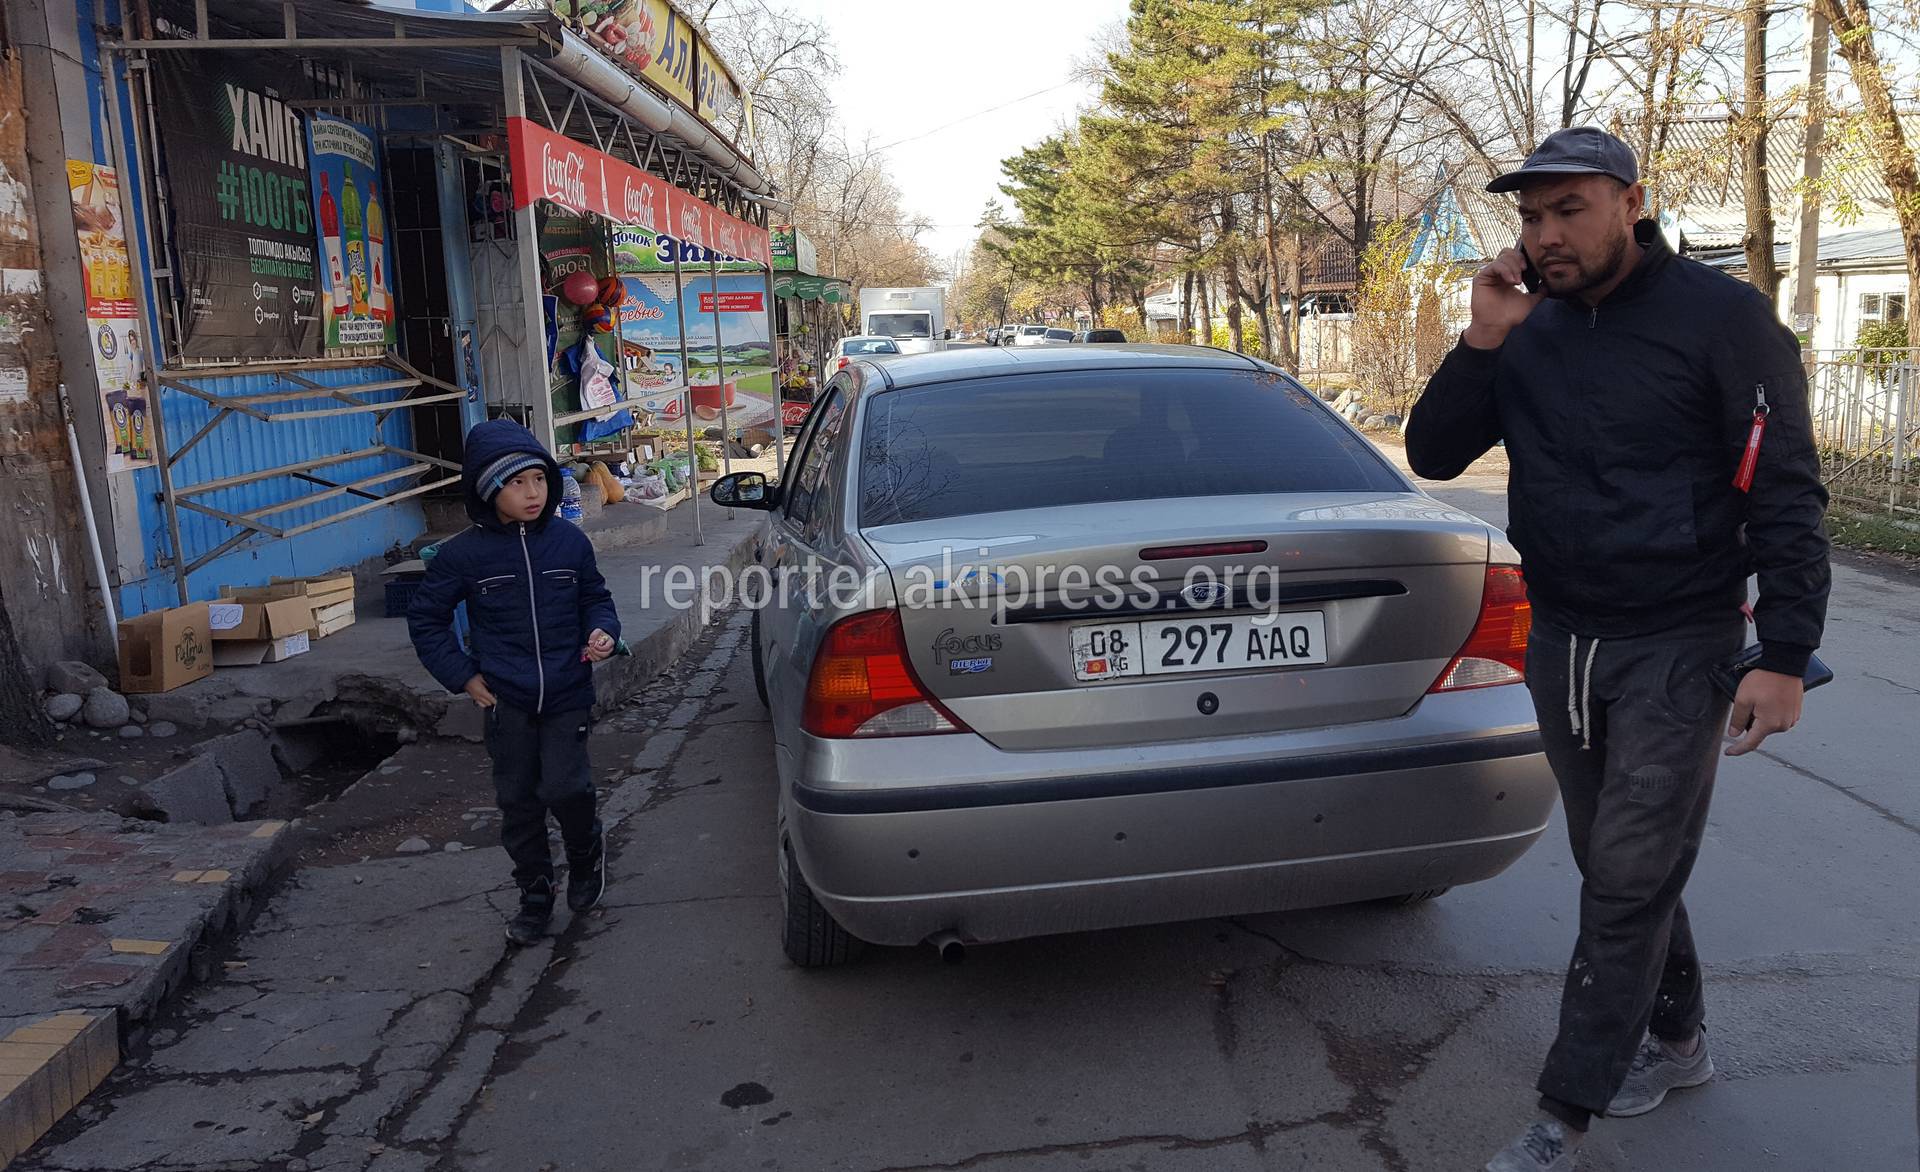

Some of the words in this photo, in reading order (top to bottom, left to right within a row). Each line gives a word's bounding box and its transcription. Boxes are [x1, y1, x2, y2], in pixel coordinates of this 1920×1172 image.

[543, 142, 587, 209] Coca-Cola
[217, 160, 308, 234] #100ГБ
[248, 238, 284, 260] ТОПТОМДО
[284, 244, 312, 263] АКЫСЫЗ
[250, 257, 287, 277] БЕСПЛАТНО
[1091, 629, 1124, 656] 08
[1160, 623, 1233, 667] 297
[1246, 625, 1311, 661] AAQ
[1109, 657, 1129, 671] KG
